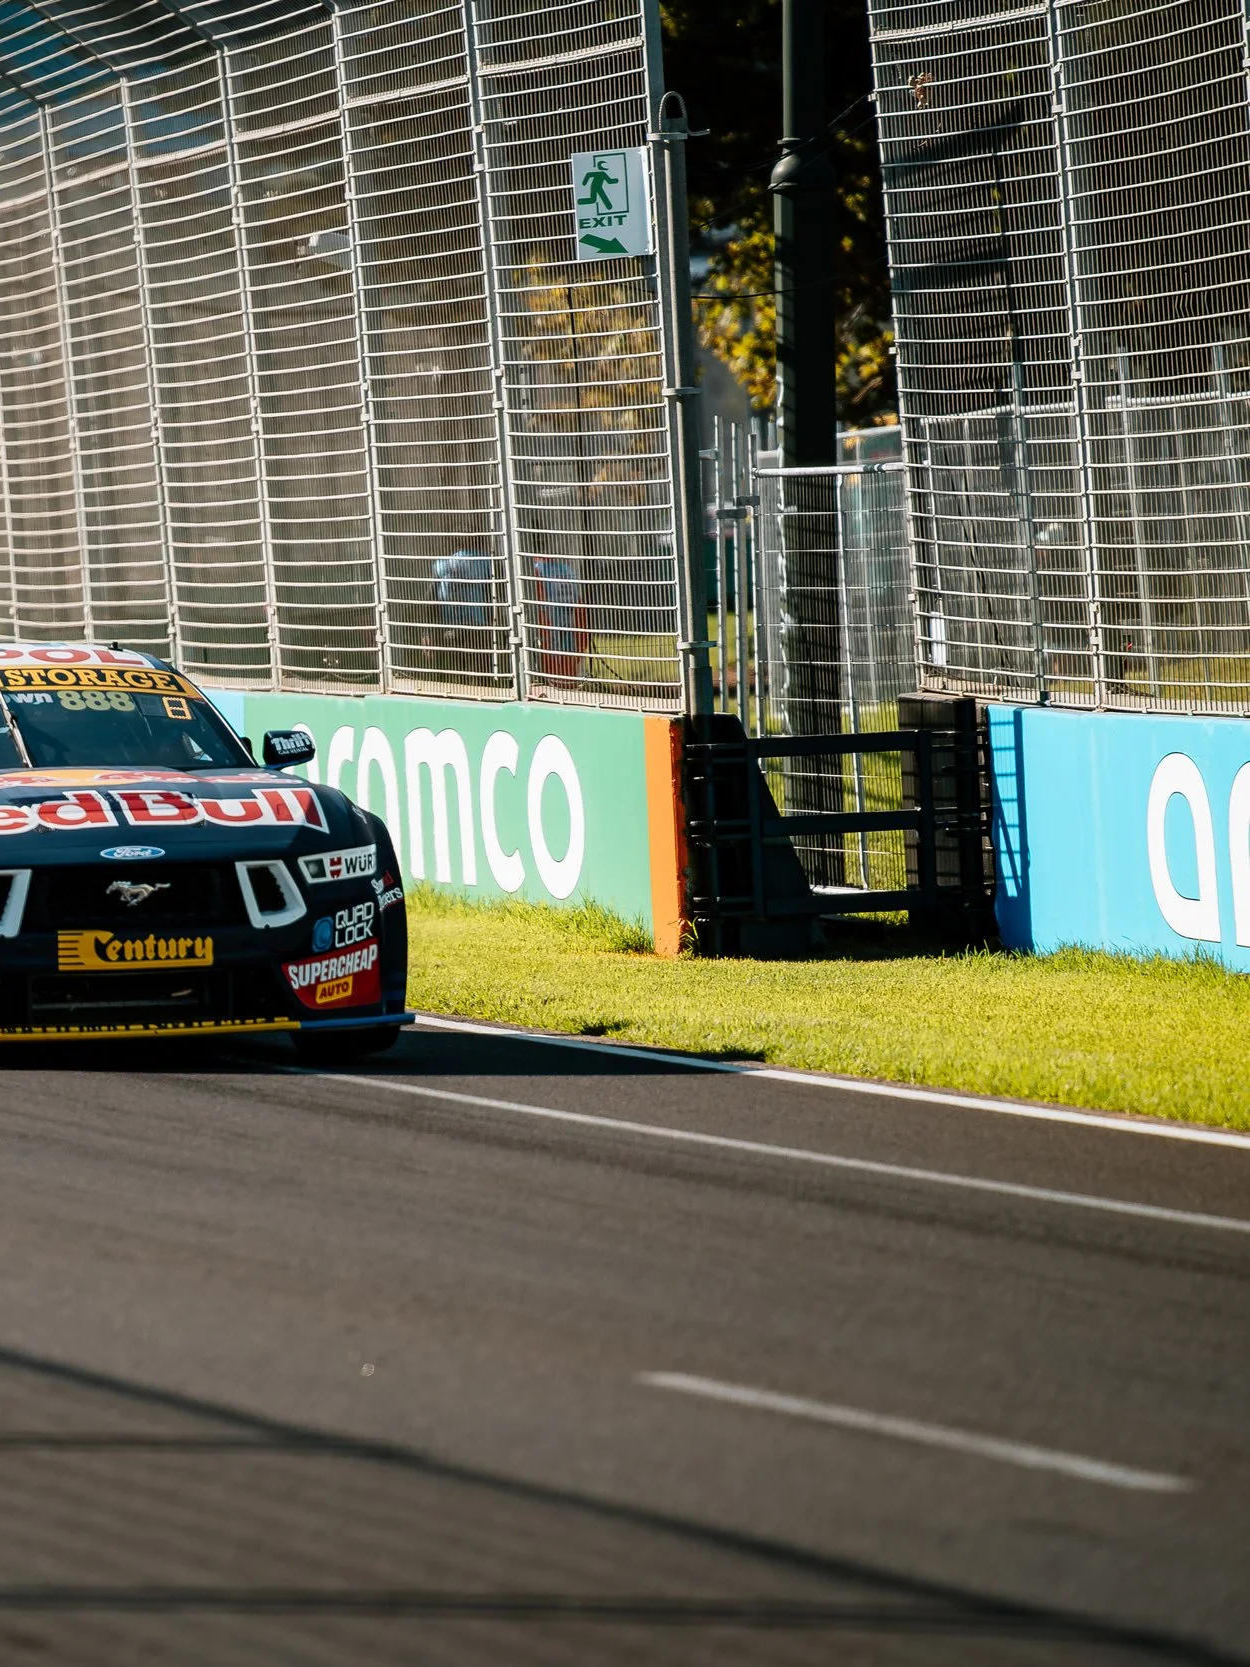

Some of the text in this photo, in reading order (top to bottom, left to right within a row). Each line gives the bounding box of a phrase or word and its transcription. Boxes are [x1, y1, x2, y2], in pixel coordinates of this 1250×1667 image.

[578, 214, 627, 230] EXIT
[4, 667, 176, 693] STORAGE
[57, 690, 135, 712] 888
[109, 787, 330, 834] Bull
[110, 846, 157, 859] Ford
[335, 901, 375, 930] QUAD
[334, 919, 373, 948] LOCK
[93, 931, 214, 966] Century
[287, 943, 378, 990] SUPERCHEAP
[318, 980, 350, 999] AUTO
